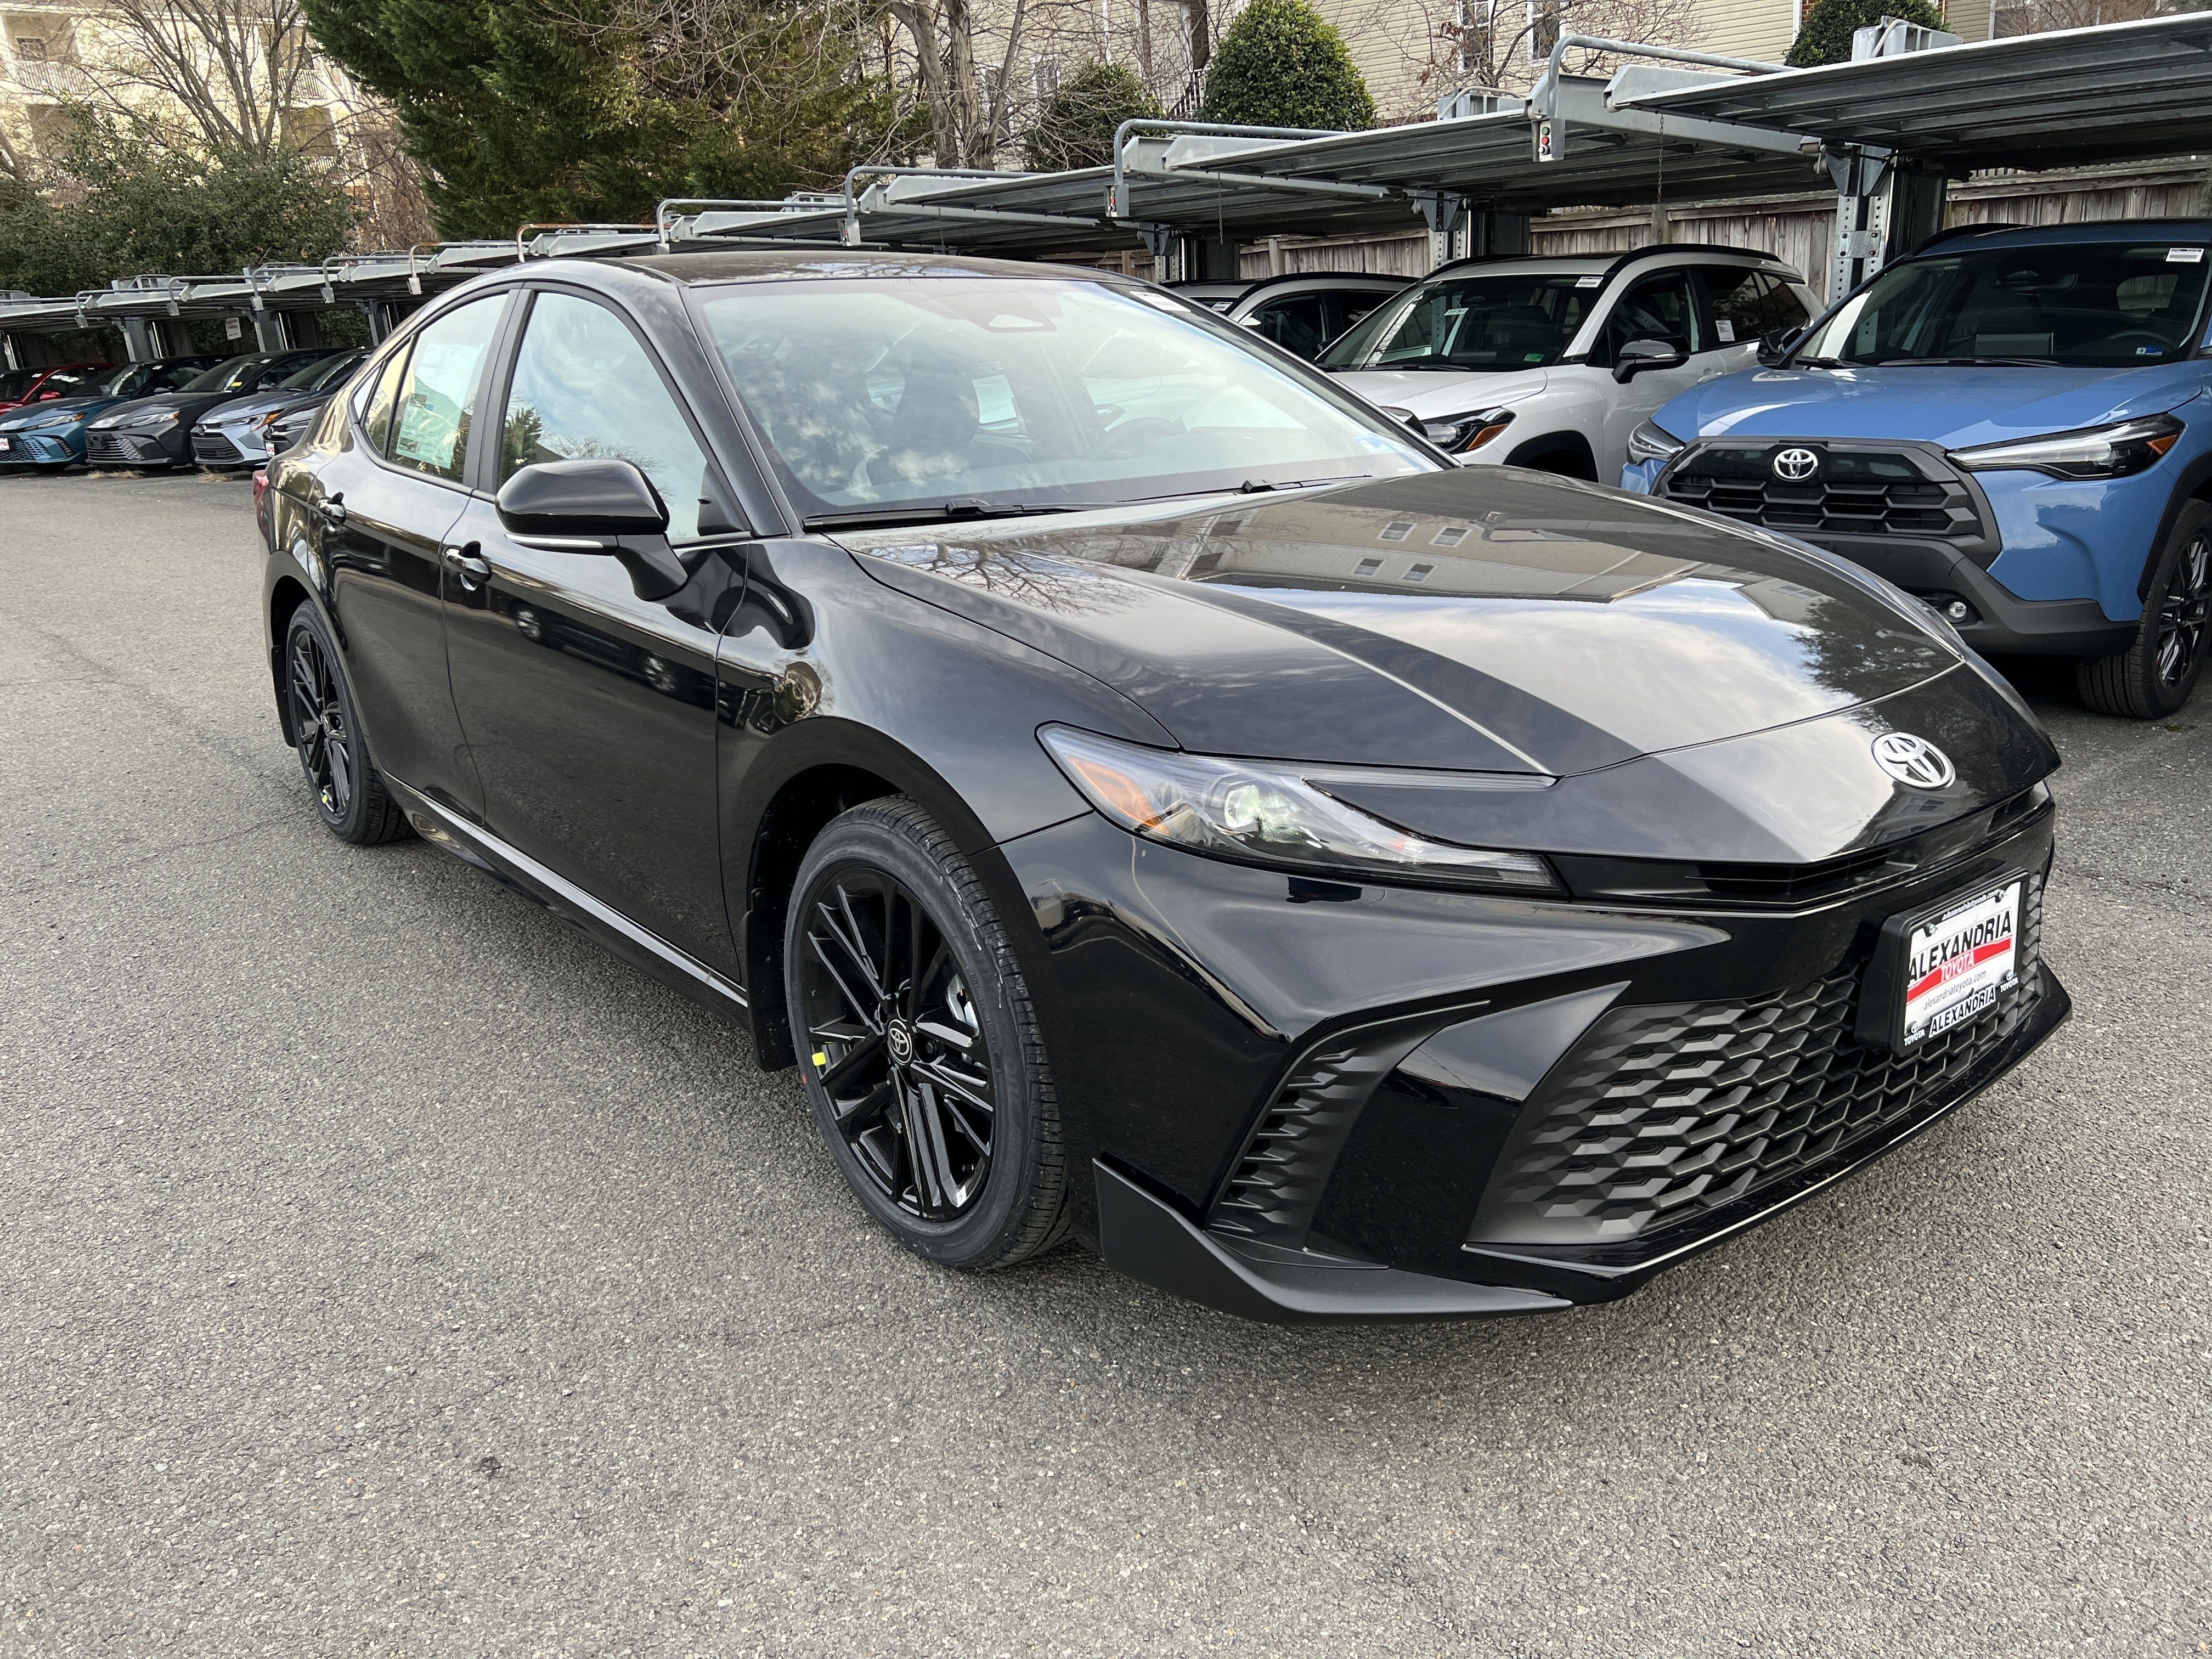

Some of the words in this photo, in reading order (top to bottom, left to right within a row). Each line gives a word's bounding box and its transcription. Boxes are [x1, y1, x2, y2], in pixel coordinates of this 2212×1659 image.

[1909, 910, 2011, 981] ALEXANDRIA
[1940, 951, 1974, 983] TOYOTA
[2000, 977, 2018, 993] TOYOTA
[1924, 970, 1986, 1011] alexandriatoyota.com
[1931, 986, 1994, 1035] ALEXANDRIA
[1904, 1029, 1925, 1046] TOYOTA
